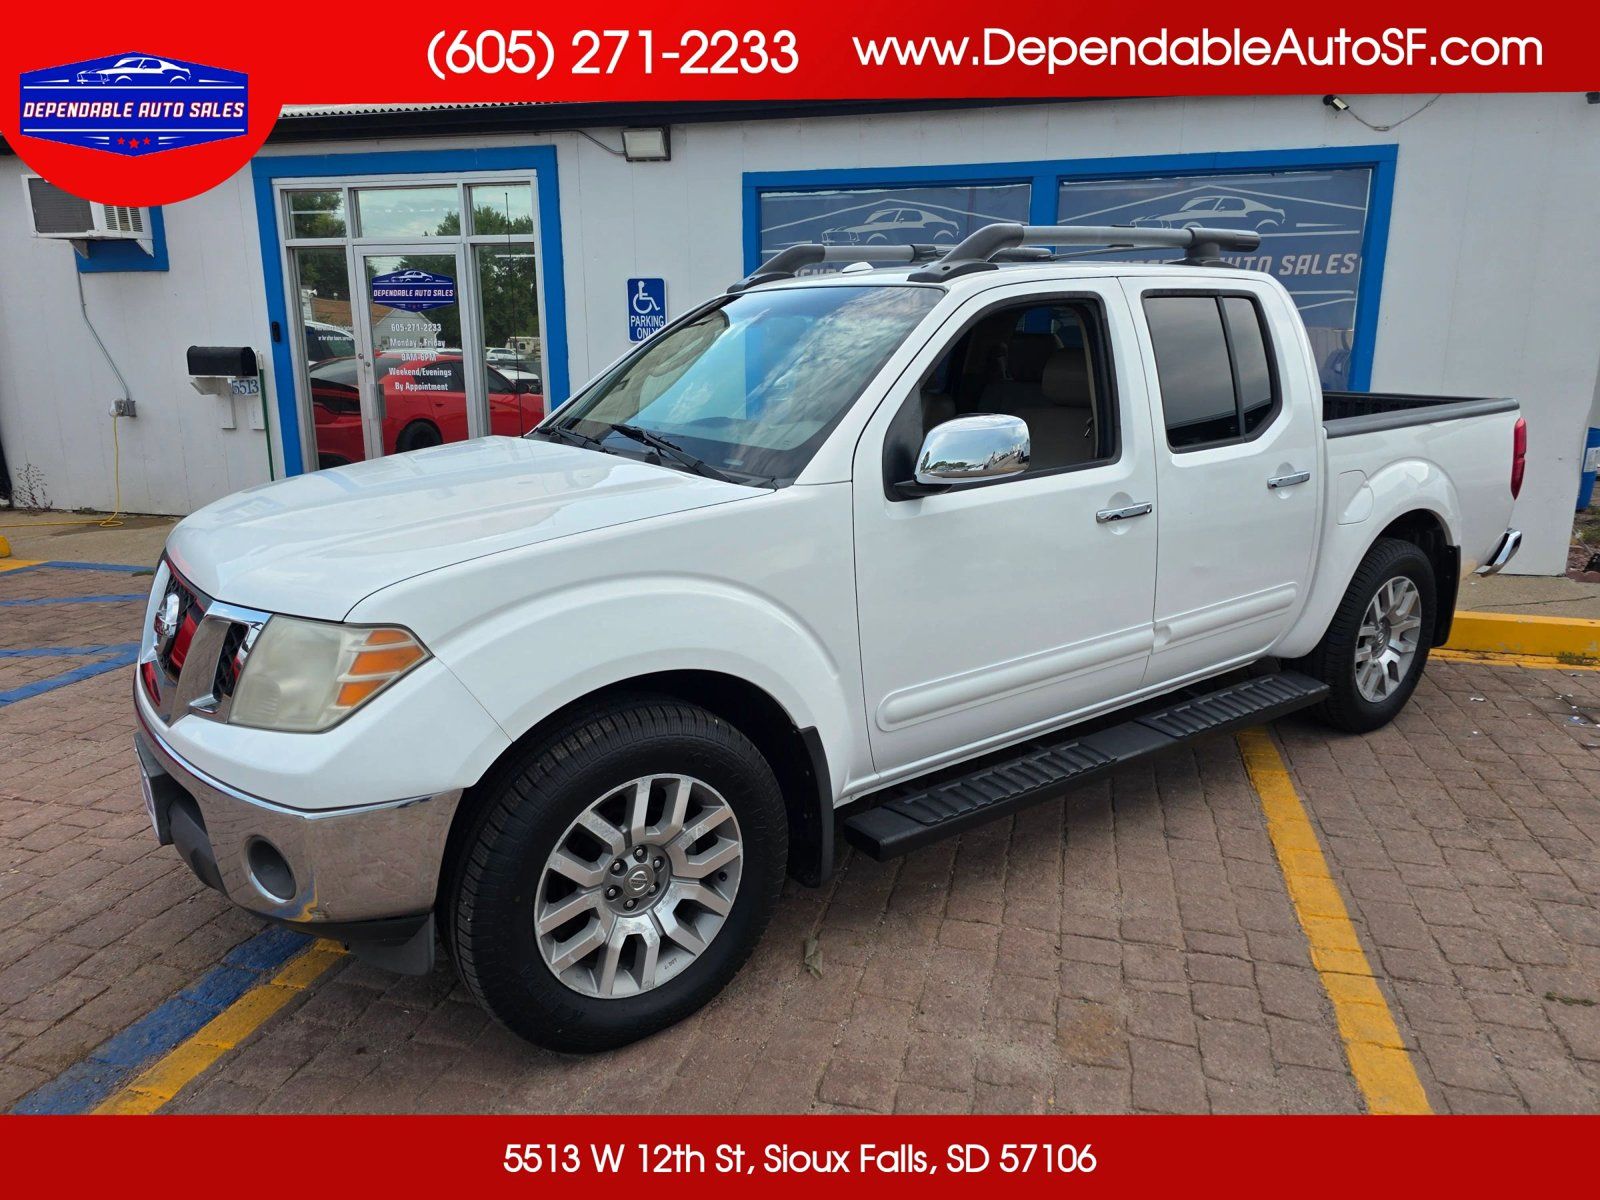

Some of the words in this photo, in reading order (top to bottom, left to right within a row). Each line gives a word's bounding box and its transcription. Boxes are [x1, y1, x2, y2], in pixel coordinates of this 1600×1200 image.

[1279, 253, 1358, 275] SALES
[373, 289, 413, 297] DEPENDABLE
[414, 289, 432, 297] AUTO
[433, 289, 454, 297] SALES
[630, 315, 665, 327] PARKING
[391, 323, 442, 332] 605-271-2233
[390, 338, 417, 347] Monday
[423, 338, 446, 347] Friday
[388, 367, 452, 378] Weekend/Evenings
[231, 379, 259, 395] 5513
[394, 381, 404, 391] By
[405, 382, 449, 391] Appointment
